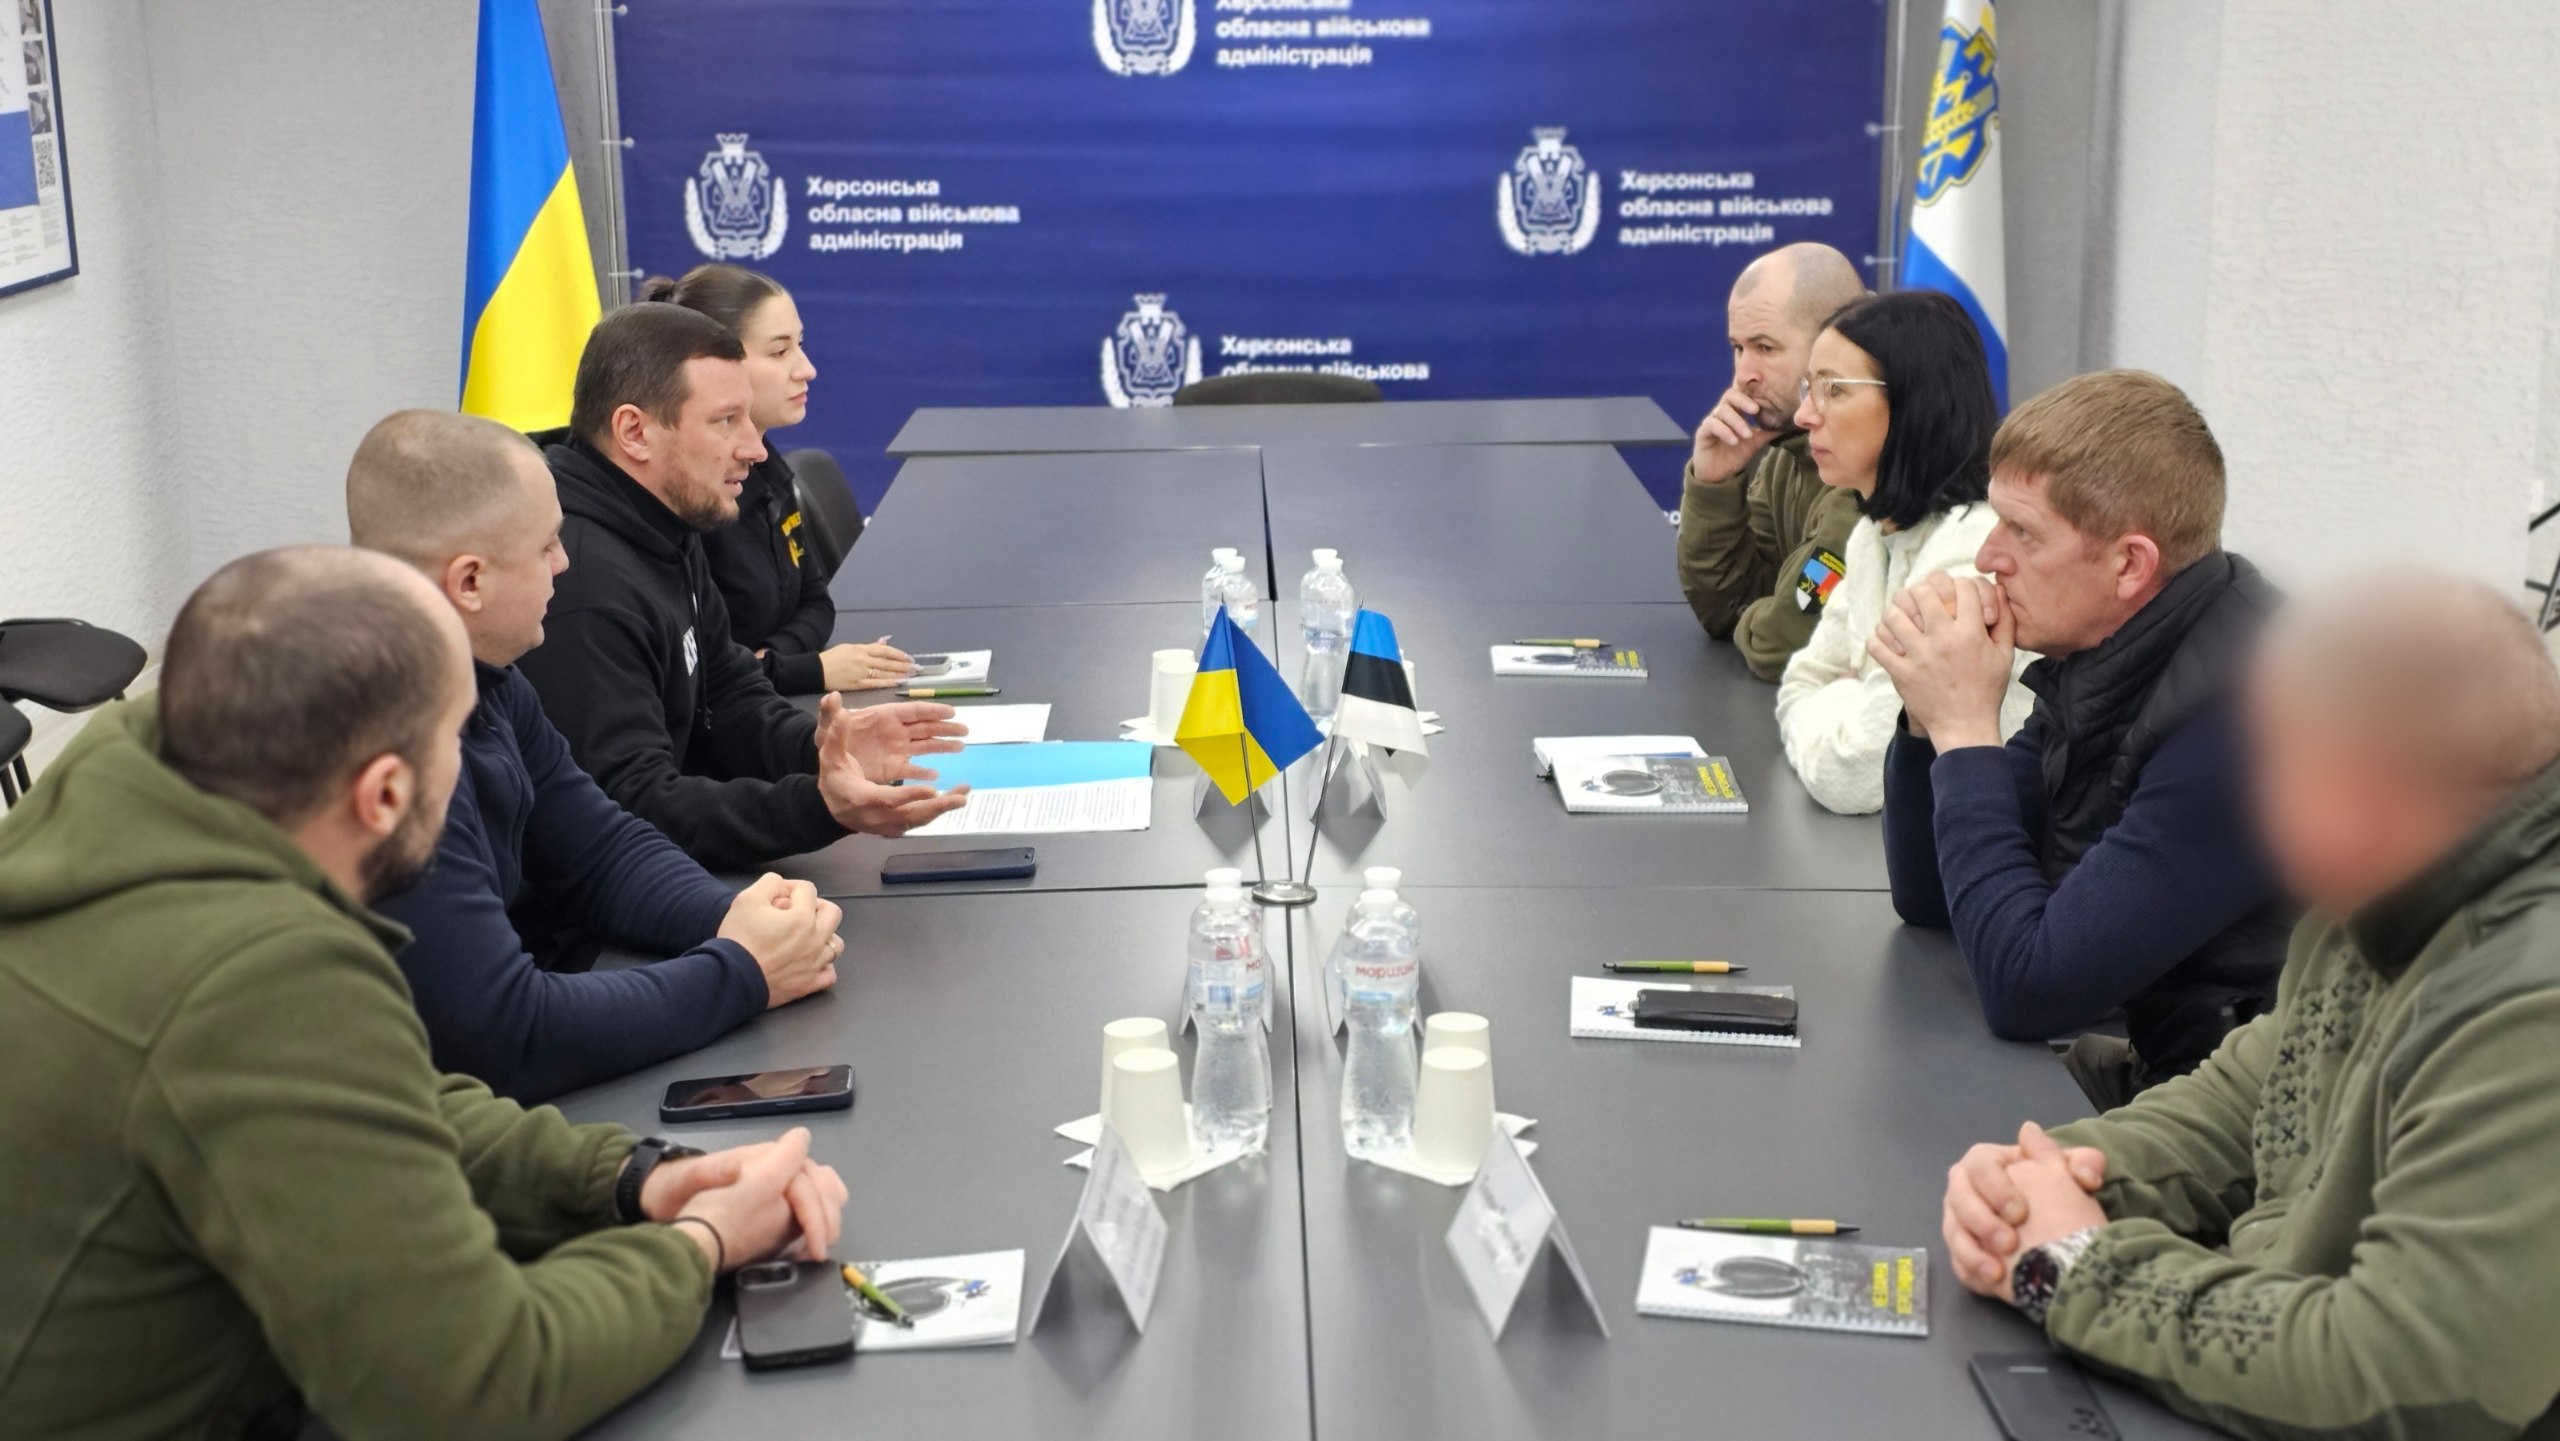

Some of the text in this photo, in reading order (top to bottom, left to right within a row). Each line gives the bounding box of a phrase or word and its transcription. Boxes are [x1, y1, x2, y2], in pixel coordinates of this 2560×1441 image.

[1215, 16, 1430, 38] обласна військова
[1216, 44, 1372, 69] адміністрація
[807, 177, 939, 199] Херсонська
[1619, 171, 1754, 194] Херсонська
[808, 203, 1020, 222] обласна військова
[1619, 197, 1832, 217] обласна військова
[809, 230, 963, 252] адміністрація
[1619, 223, 1774, 246] адміністрація
[1221, 336, 1352, 358] Херсонська
